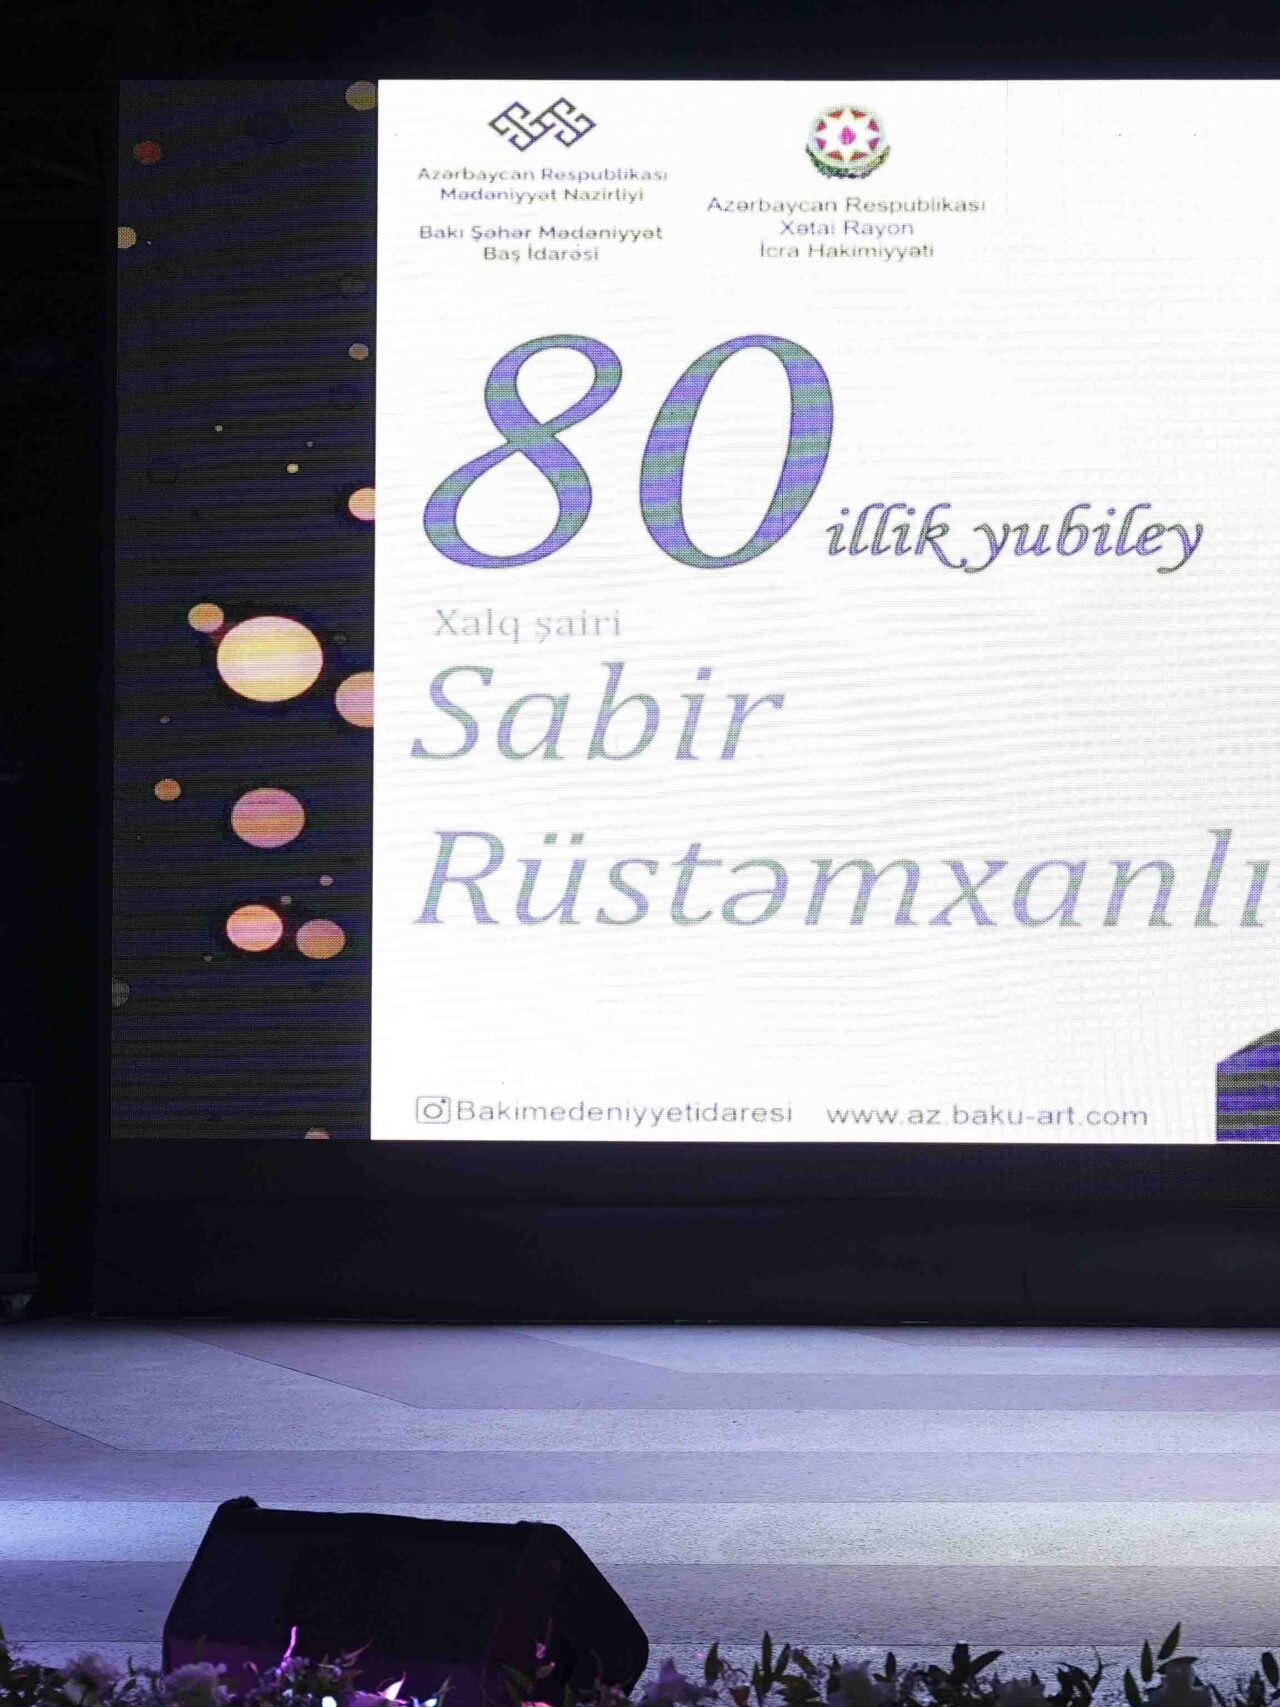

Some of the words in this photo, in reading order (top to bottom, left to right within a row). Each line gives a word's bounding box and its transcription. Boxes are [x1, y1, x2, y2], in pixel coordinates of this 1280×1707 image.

[417, 167, 535, 184] Azərbaycan
[541, 167, 668, 184] Respublikası
[440, 187, 557, 204] Mədəniyyət
[563, 187, 644, 204] Nazirliyi
[706, 196, 838, 215] Azərbaycan
[846, 196, 986, 215] Respublikası
[418, 225, 464, 240] Bakı
[470, 225, 532, 246] Şəhər
[538, 225, 663, 246] Mədəniyyət
[780, 220, 836, 236] Xətai
[843, 219, 914, 239] Rayon
[483, 246, 521, 264] Baş
[760, 241, 800, 258] İcra
[422, 334, 834, 570] 80
[826, 502, 968, 570] illik
[966, 502, 1204, 574] yubiley
[435, 608, 519, 643] Xalq
[535, 609, 621, 643] şairi
[411, 661, 785, 760] Sabir
[414, 827, 1270, 928] Rüstəmxanlı
[827, 1105, 1147, 1126] www.az.baku-art.com
